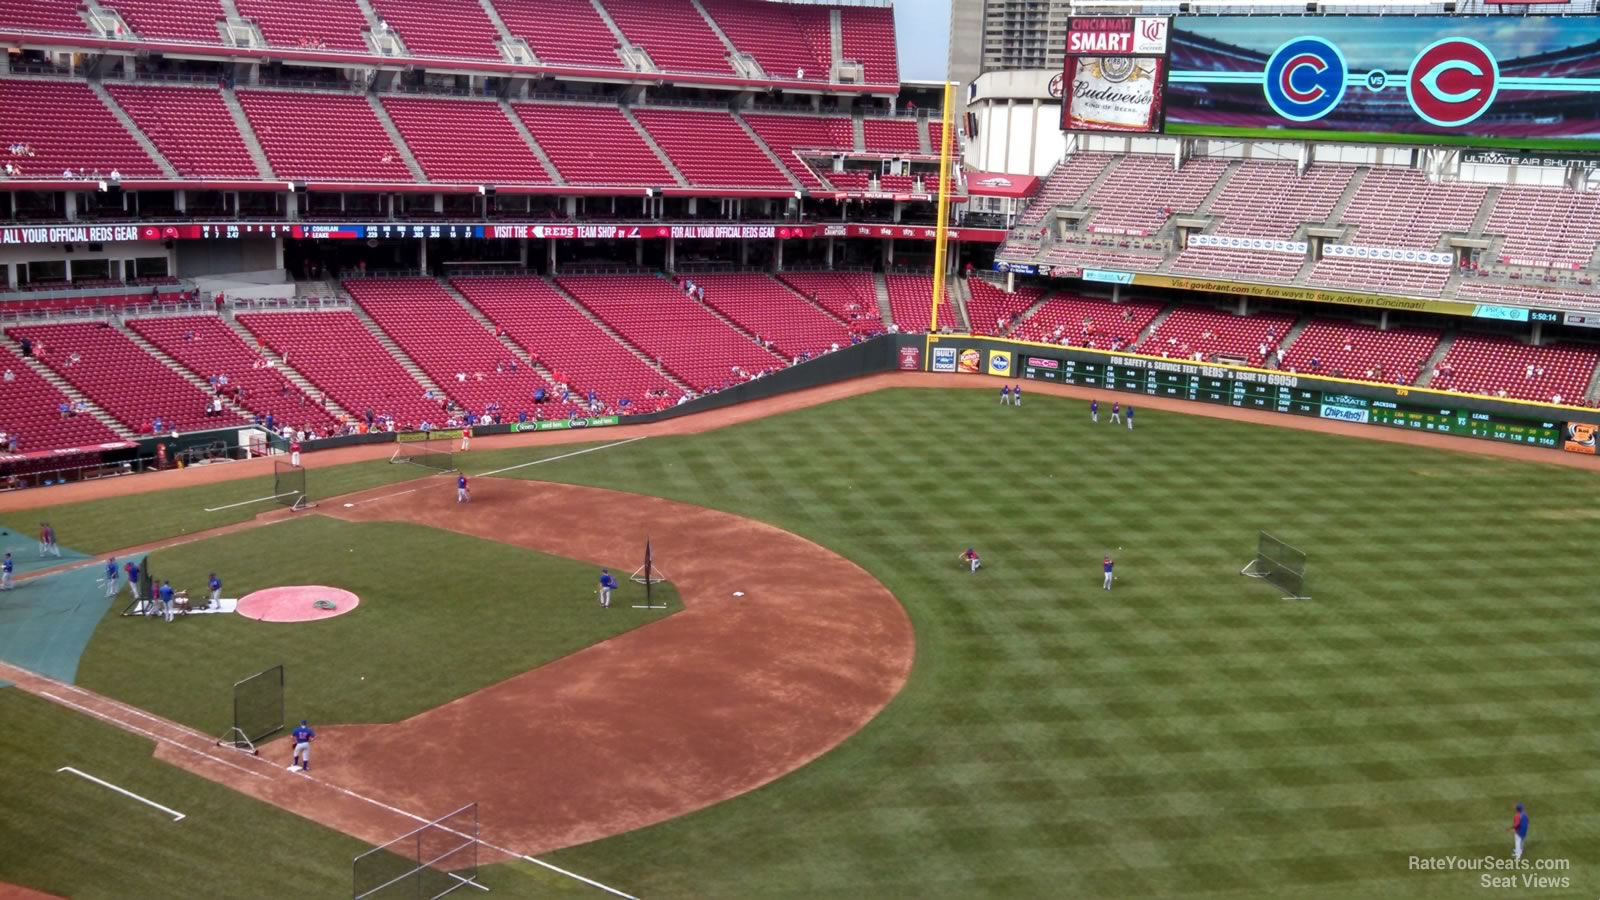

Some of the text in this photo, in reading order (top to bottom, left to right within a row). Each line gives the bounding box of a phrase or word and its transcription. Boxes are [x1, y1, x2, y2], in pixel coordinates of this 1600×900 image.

[1072, 18, 1131, 30] CINCINNATI
[1070, 32, 1131, 51] SMART
[1370, 76, 1384, 85] VS
[1073, 79, 1155, 104] Budweiser
[1464, 154, 1519, 165] ULTIMATE
[1543, 159, 1598, 168] SHUTTLE
[3, 228, 21, 244] ALL
[22, 228, 48, 243] YOUR
[49, 227, 89, 243] OFFICIAL
[90, 226, 113, 241] REDS
[114, 226, 138, 241] GEAR
[494, 226, 625, 238] VISIT THE REDS TEAM SHOP BY
[671, 226, 776, 238] FOR ALL YOUR OFFICIAL REDS GEAR
[1171, 279, 1189, 288] Visit
[1190, 281, 1249, 293] govibrant.com
[1251, 286, 1264, 294] for
[1265, 287, 1279, 296] fun
[1281, 291, 1304, 300] ways
[1317, 294, 1334, 302] stay
[1336, 295, 1364, 304] active
[1365, 297, 1374, 305] in
[1376, 298, 1425, 310] Cincinnati!
[1531, 312, 1557, 321] 5:50:14
[1110, 356, 1123, 365] FOR
[1124, 358, 1147, 368] SAFETY
[1154, 361, 1181, 373] SERVICE
[1182, 365, 1198, 374] TEXT
[1228, 371, 1234, 379] &
[1236, 371, 1257, 381] ISSUE
[1257, 374, 1267, 383] TO
[1268, 374, 1298, 388] 69050
[1325, 395, 1367, 406] ULTIMATE
[1372, 401, 1397, 409] JACKSON
[1325, 407, 1365, 421] Chips Ahoy!
